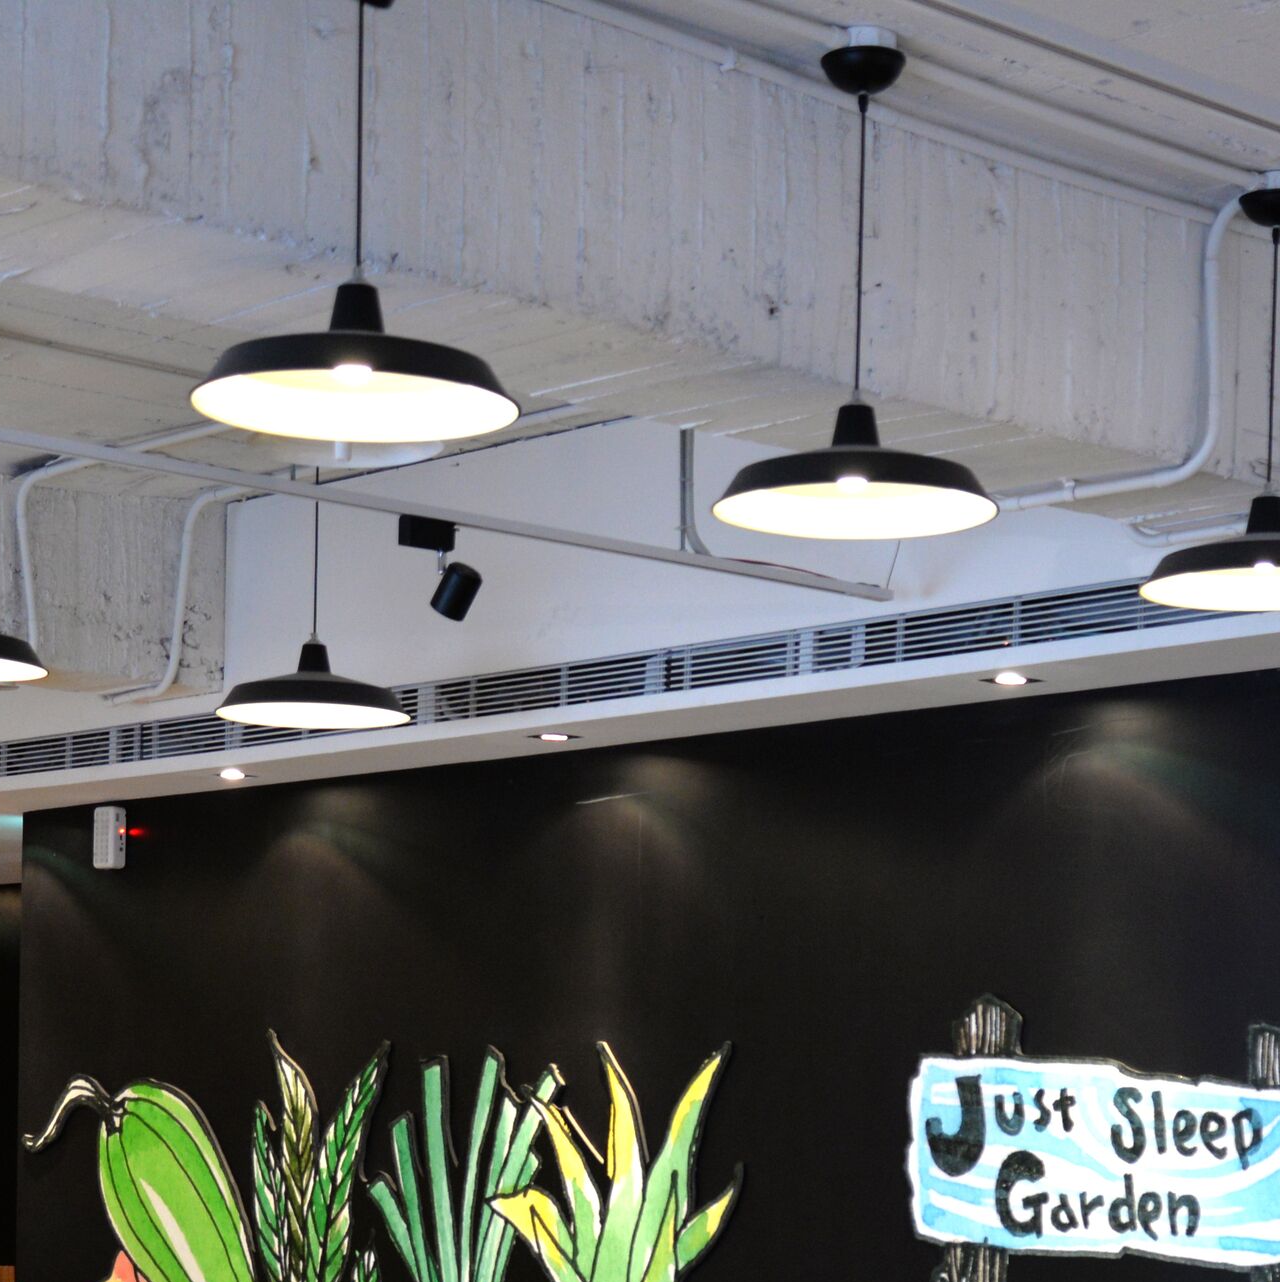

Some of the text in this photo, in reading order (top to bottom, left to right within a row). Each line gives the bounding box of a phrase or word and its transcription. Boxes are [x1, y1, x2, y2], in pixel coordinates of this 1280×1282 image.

[925, 1074, 1263, 1177] Just Sleep
[995, 1150, 1201, 1240] Garden
